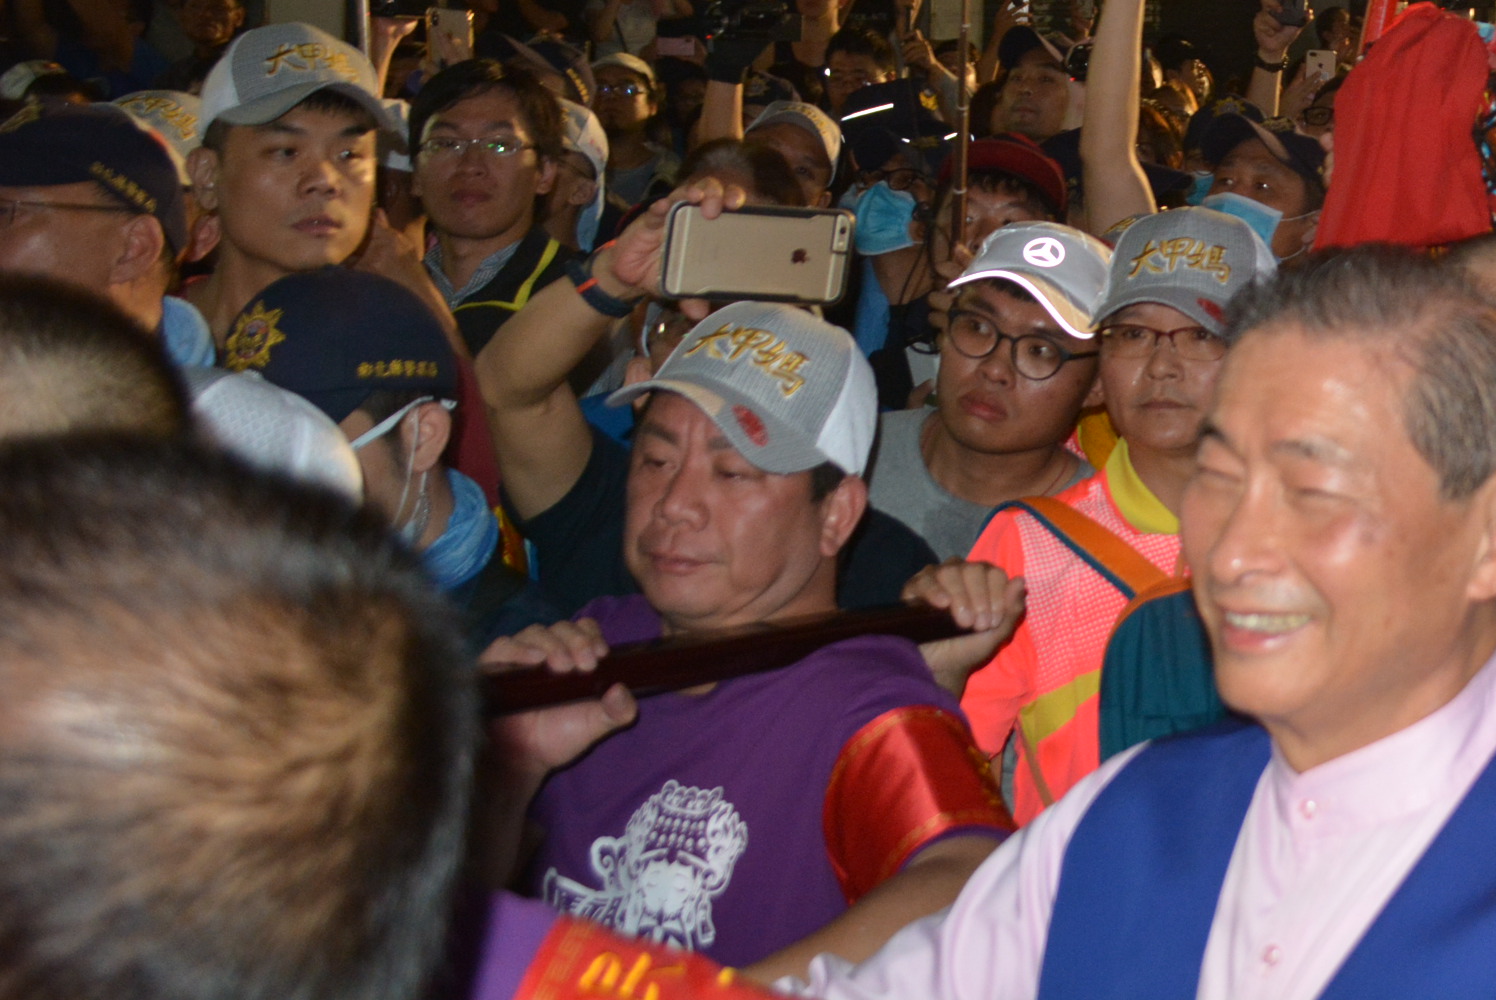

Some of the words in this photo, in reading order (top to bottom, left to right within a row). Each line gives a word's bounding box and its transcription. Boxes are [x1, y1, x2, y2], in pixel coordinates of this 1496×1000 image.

[1127, 237, 1233, 284] 大甲媽
[682, 322, 812, 398] 大甲媽
